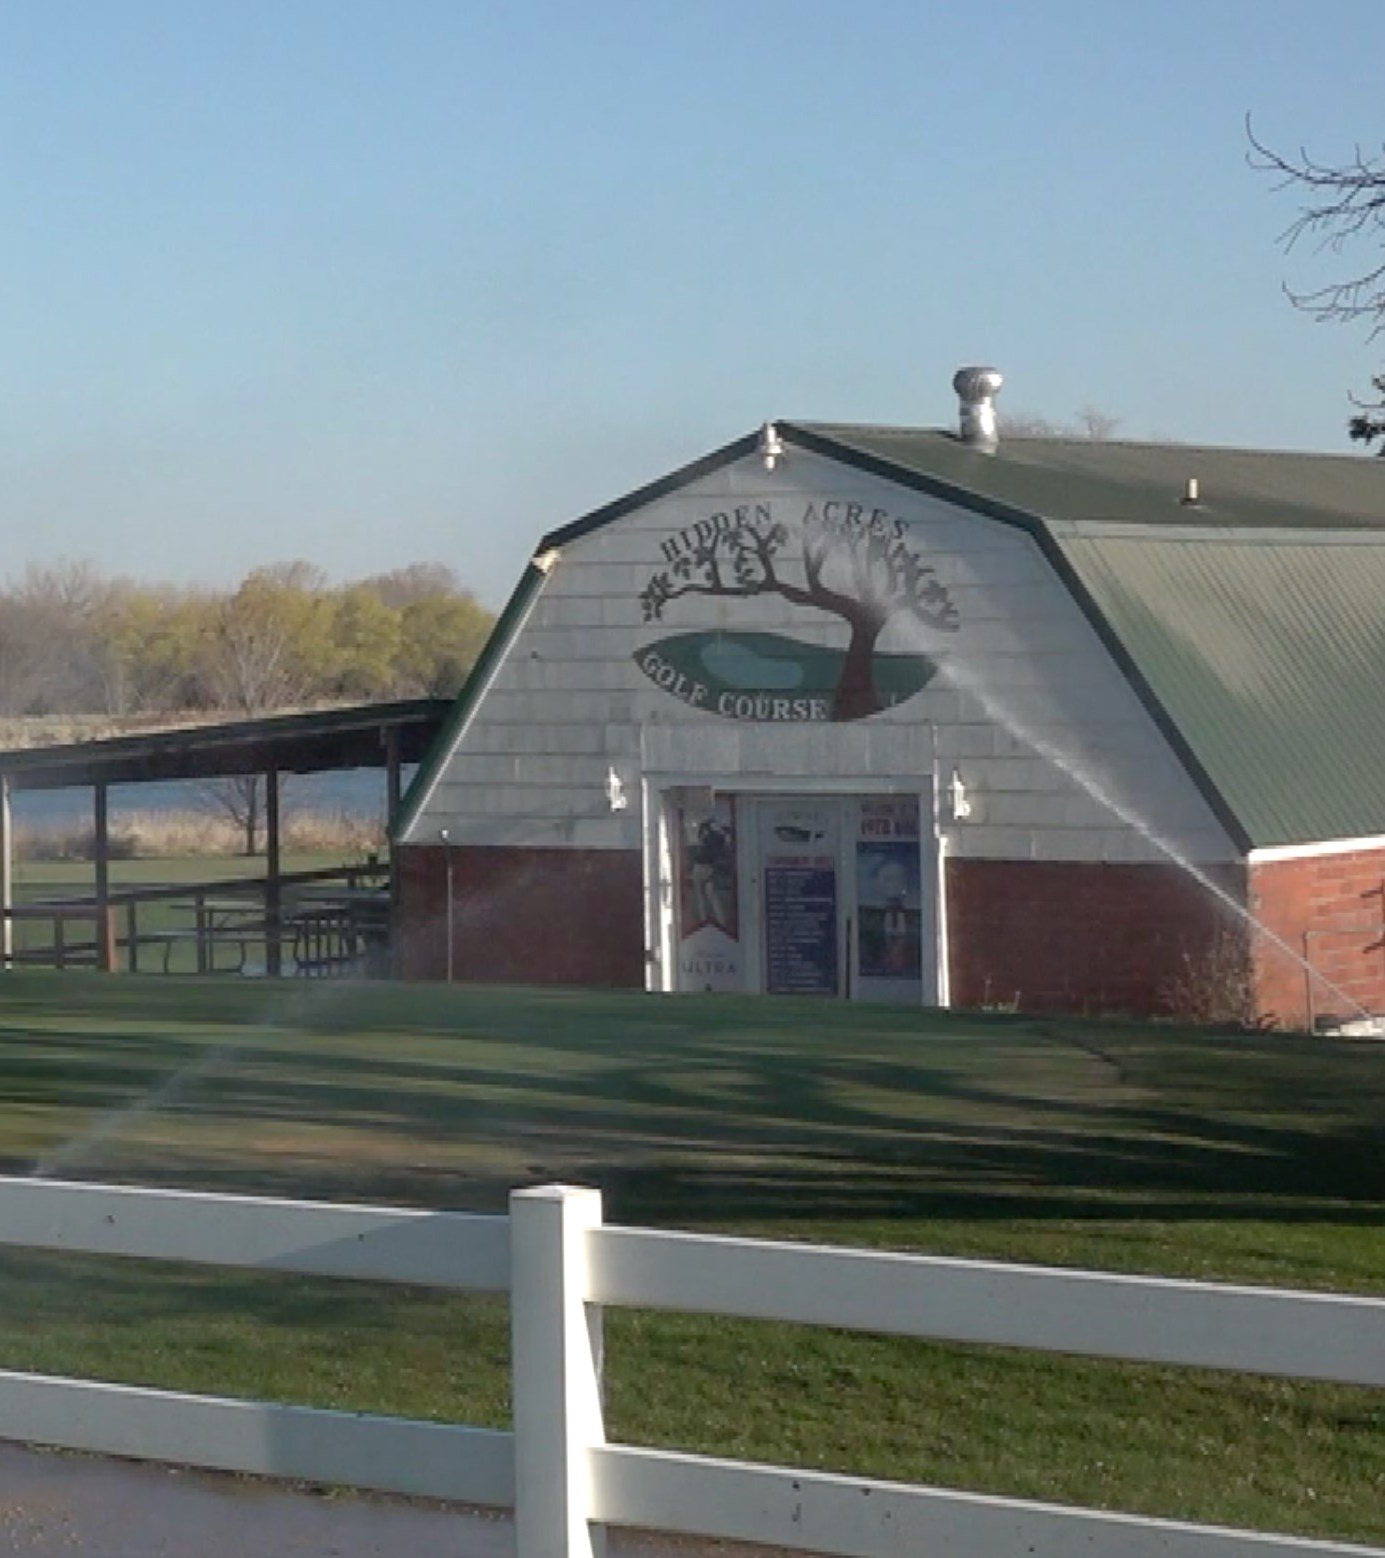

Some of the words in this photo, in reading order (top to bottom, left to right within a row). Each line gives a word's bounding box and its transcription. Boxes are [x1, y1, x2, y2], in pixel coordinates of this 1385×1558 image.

[660, 501, 771, 562] HIDDEN
[802, 501, 910, 540] ACRES
[643, 652, 708, 704] GOLF
[718, 692, 827, 720] COURSE
[682, 960, 737, 975] ULTRA
